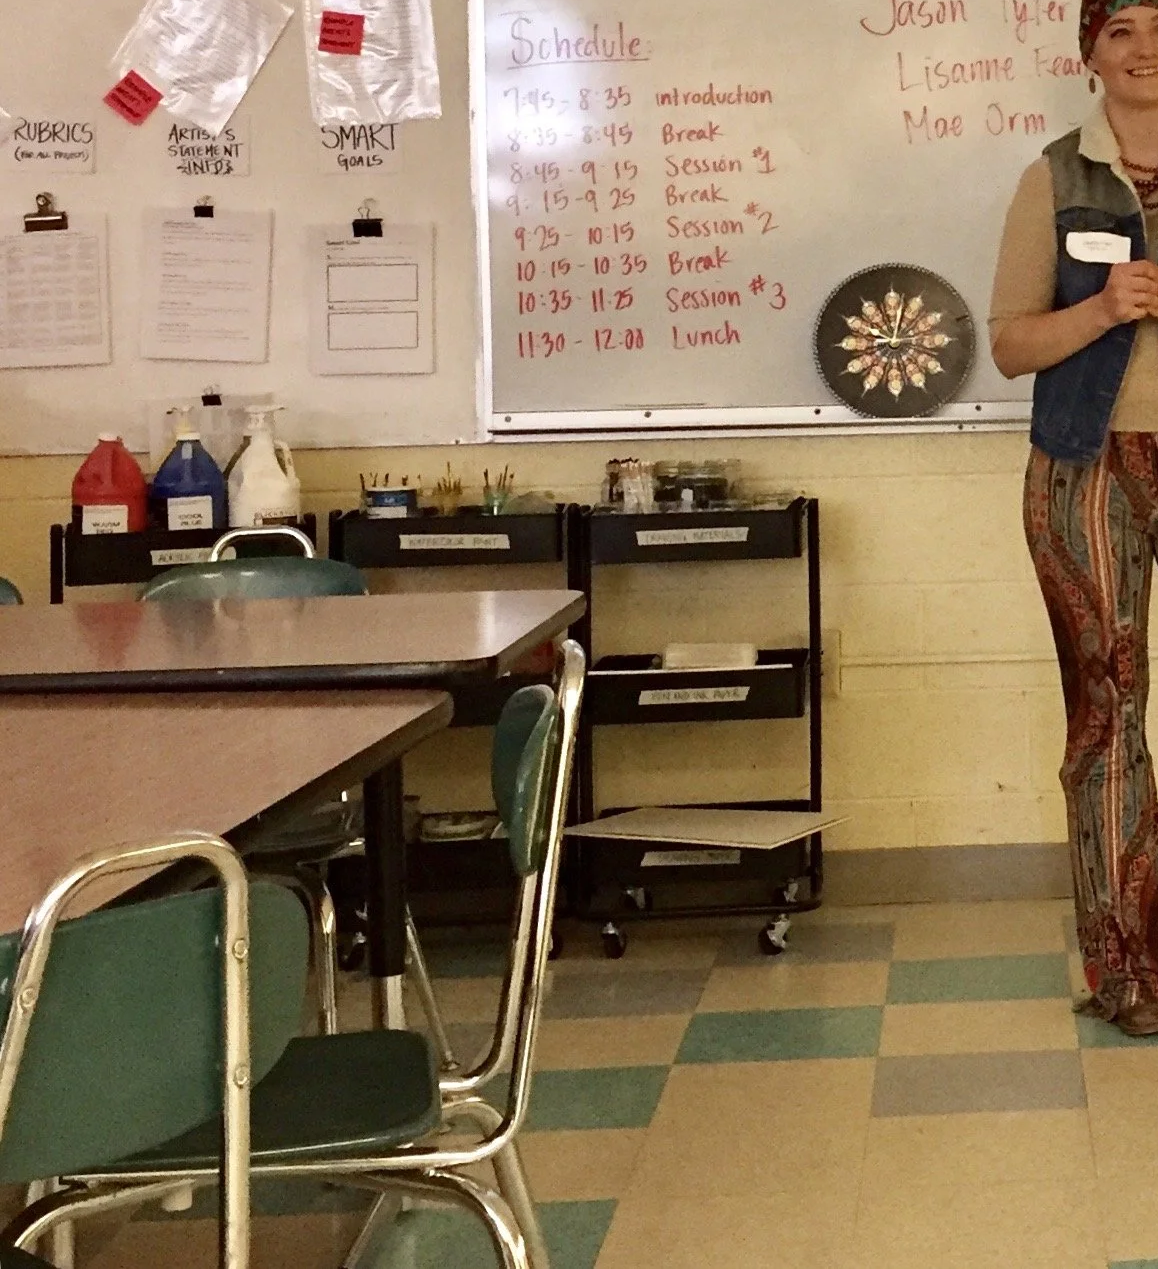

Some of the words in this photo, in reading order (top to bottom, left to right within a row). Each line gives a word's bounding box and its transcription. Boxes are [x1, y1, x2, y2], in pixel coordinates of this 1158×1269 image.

[897, 51, 1015, 92] Lisanne
[656, 83, 774, 107] introduction
[14, 117, 93, 144] RUBRICS
[168, 123, 236, 144] ARTISS
[321, 123, 399, 151] SMART
[662, 121, 722, 146] Break
[903, 105, 963, 144] Mae
[168, 143, 244, 159] STATEMENT
[337, 153, 383, 171] GOALS
[665, 154, 742, 179] Session
[665, 183, 729, 207] Break
[667, 214, 744, 239] Session
[668, 245, 734, 276] Break
[666, 287, 742, 313] Session
[671, 319, 742, 350] Lunch
